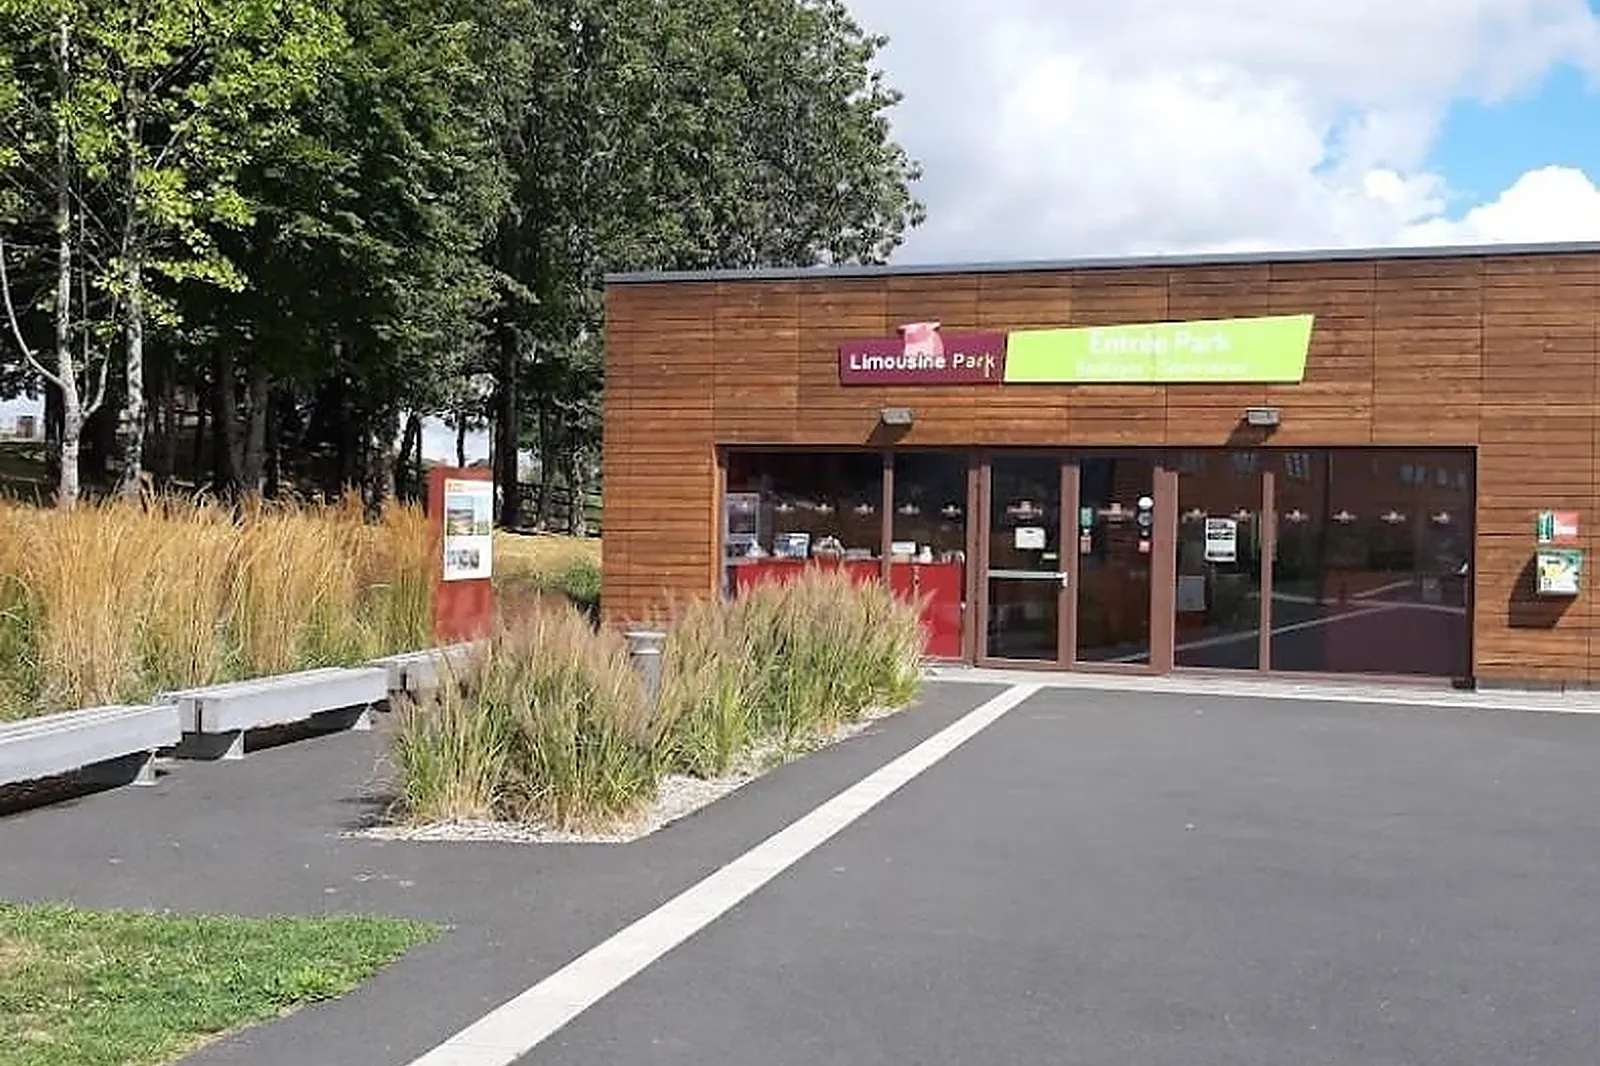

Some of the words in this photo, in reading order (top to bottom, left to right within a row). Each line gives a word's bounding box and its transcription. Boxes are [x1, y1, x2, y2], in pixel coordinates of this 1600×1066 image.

[1174, 329, 1230, 353] Park
[850, 353, 946, 371] Limousine
[953, 352, 995, 378] Park
